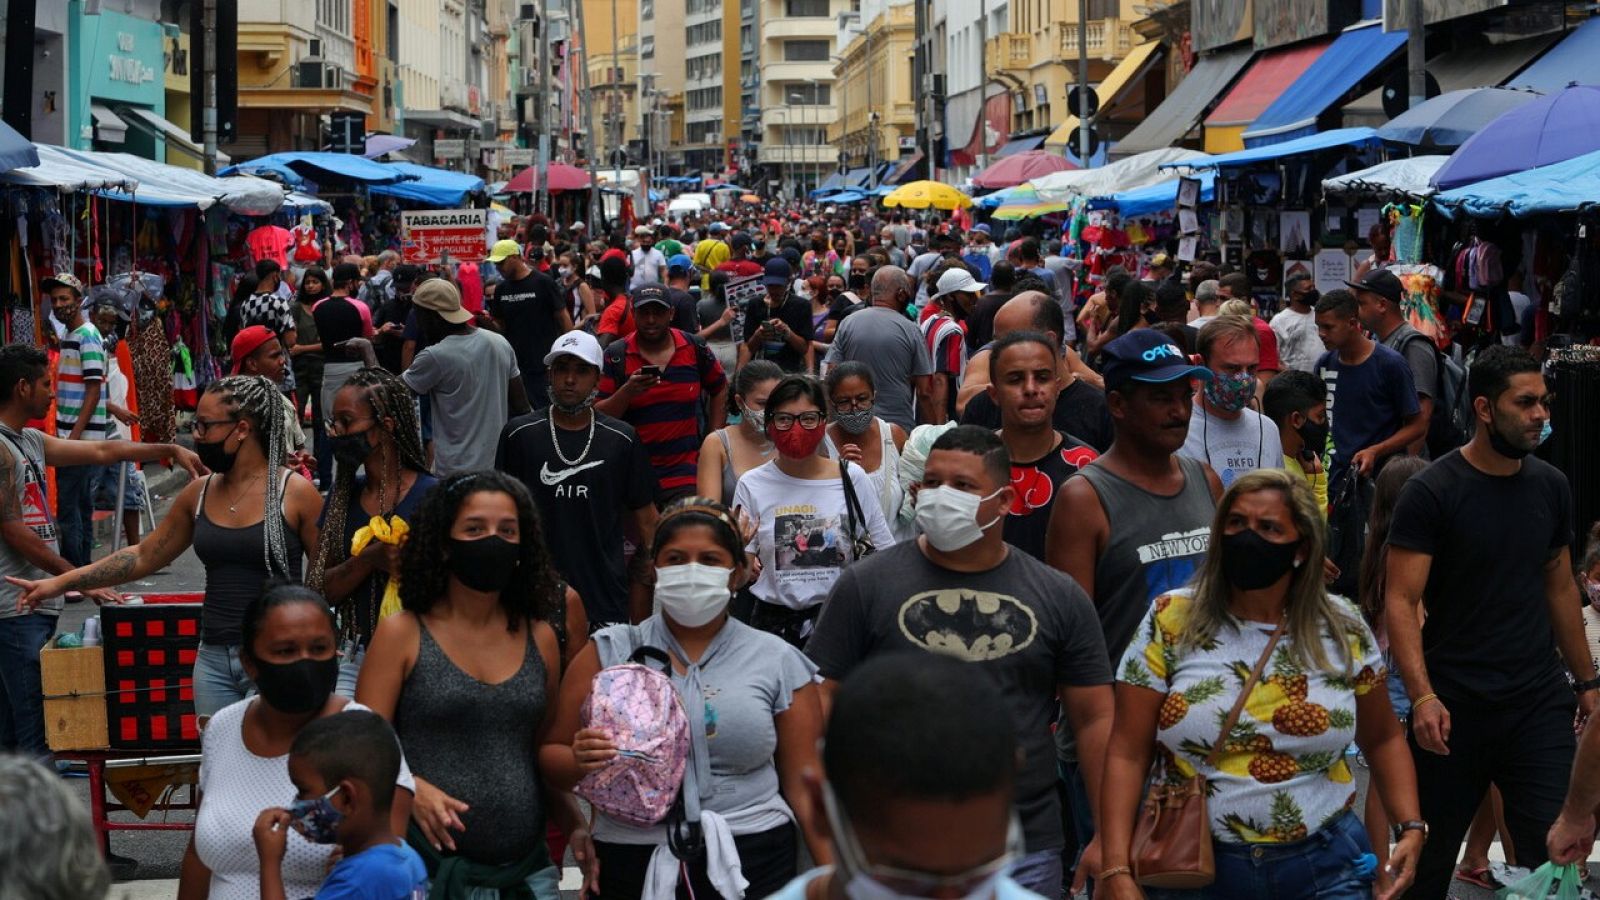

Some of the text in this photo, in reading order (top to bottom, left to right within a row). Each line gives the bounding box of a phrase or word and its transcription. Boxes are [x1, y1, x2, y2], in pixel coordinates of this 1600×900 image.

[404, 214, 481, 226] TABACARIA
[432, 235, 461, 245] MONTE
[555, 484, 589, 499] AIR
[1149, 540, 1181, 560] NEW
